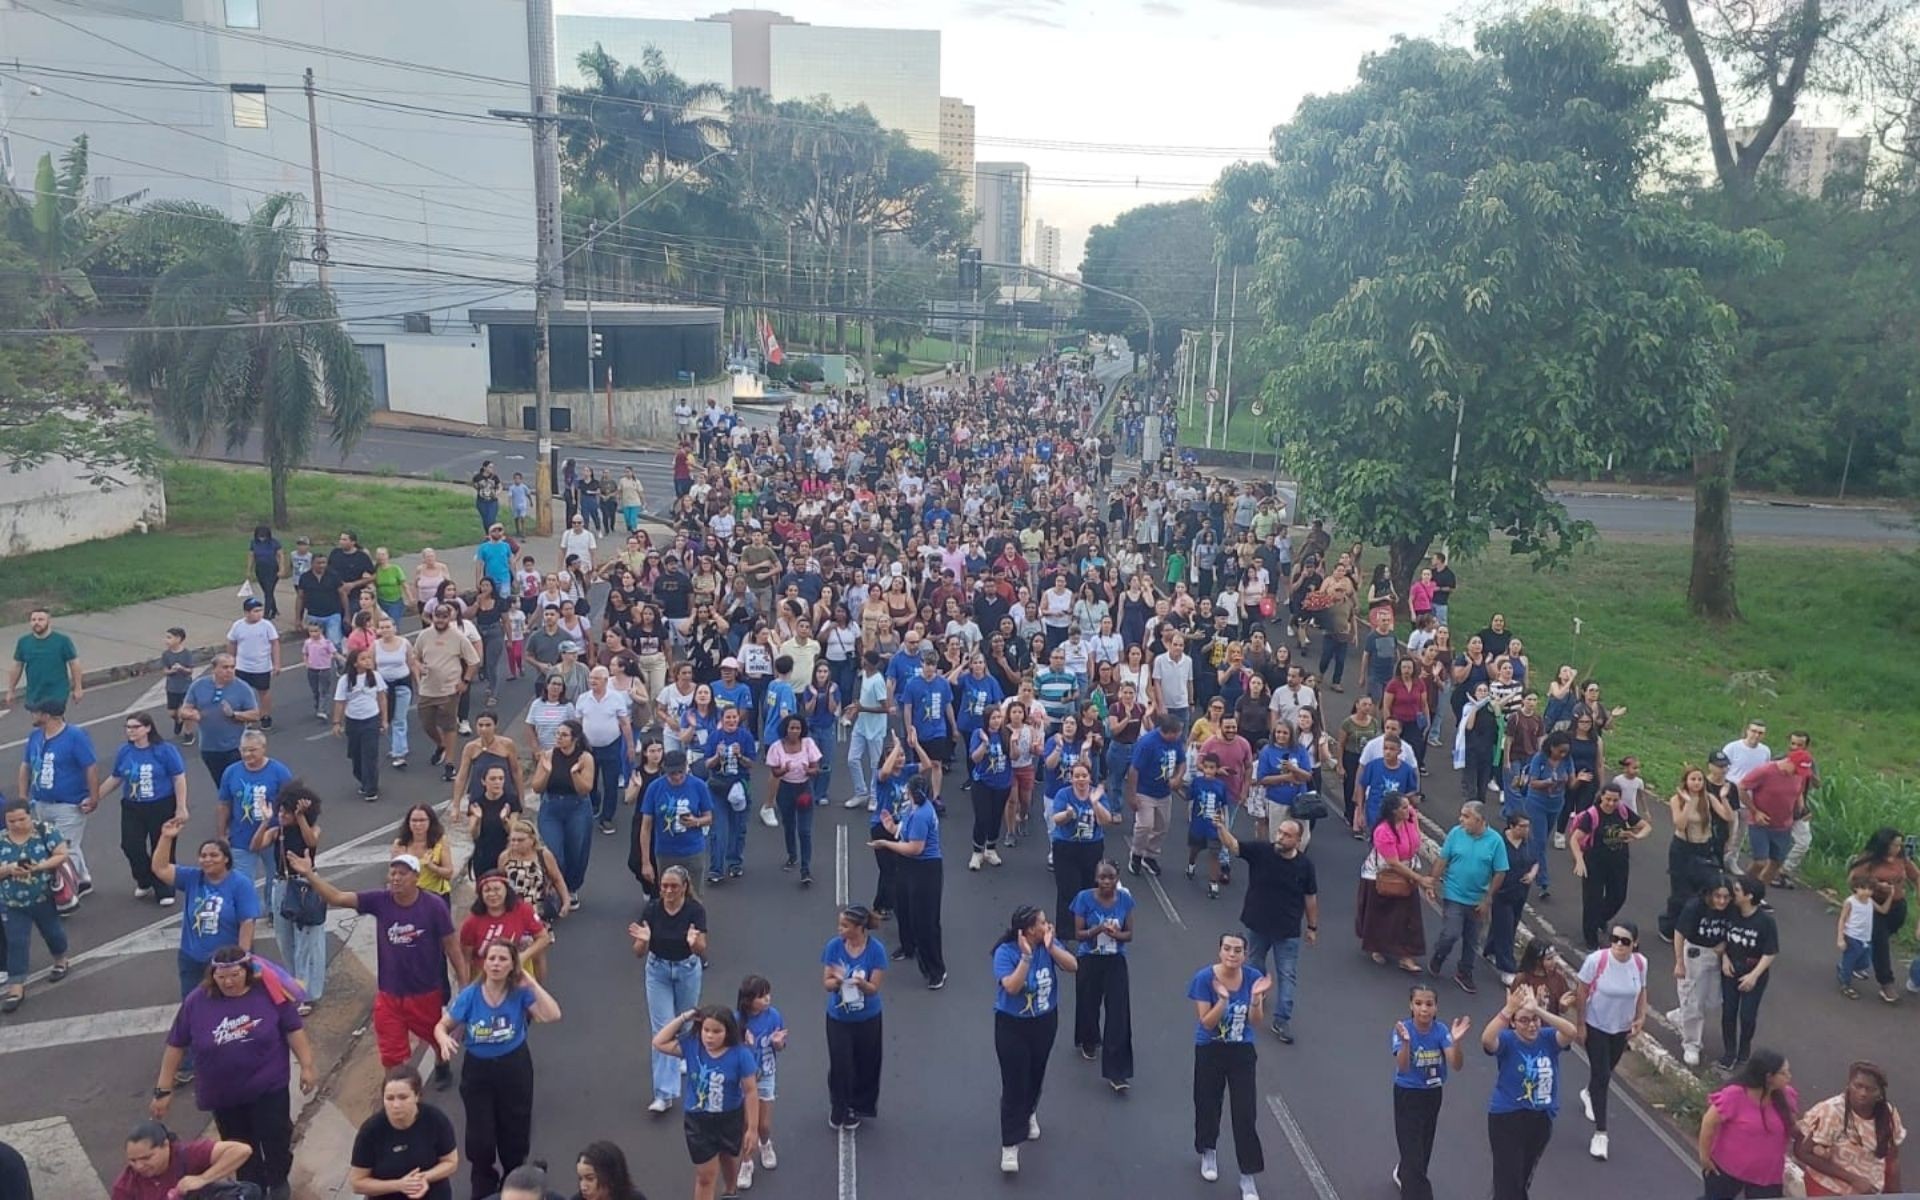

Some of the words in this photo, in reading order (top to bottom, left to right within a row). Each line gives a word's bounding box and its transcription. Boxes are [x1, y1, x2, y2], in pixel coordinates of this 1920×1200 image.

[40, 752, 54, 789] JESUS
[140, 763, 155, 798] JESUS
[1036, 968, 1052, 1011] JESUS
[1231, 1004, 1248, 1041] JESUS
[1536, 1056, 1553, 1104] JESUS
